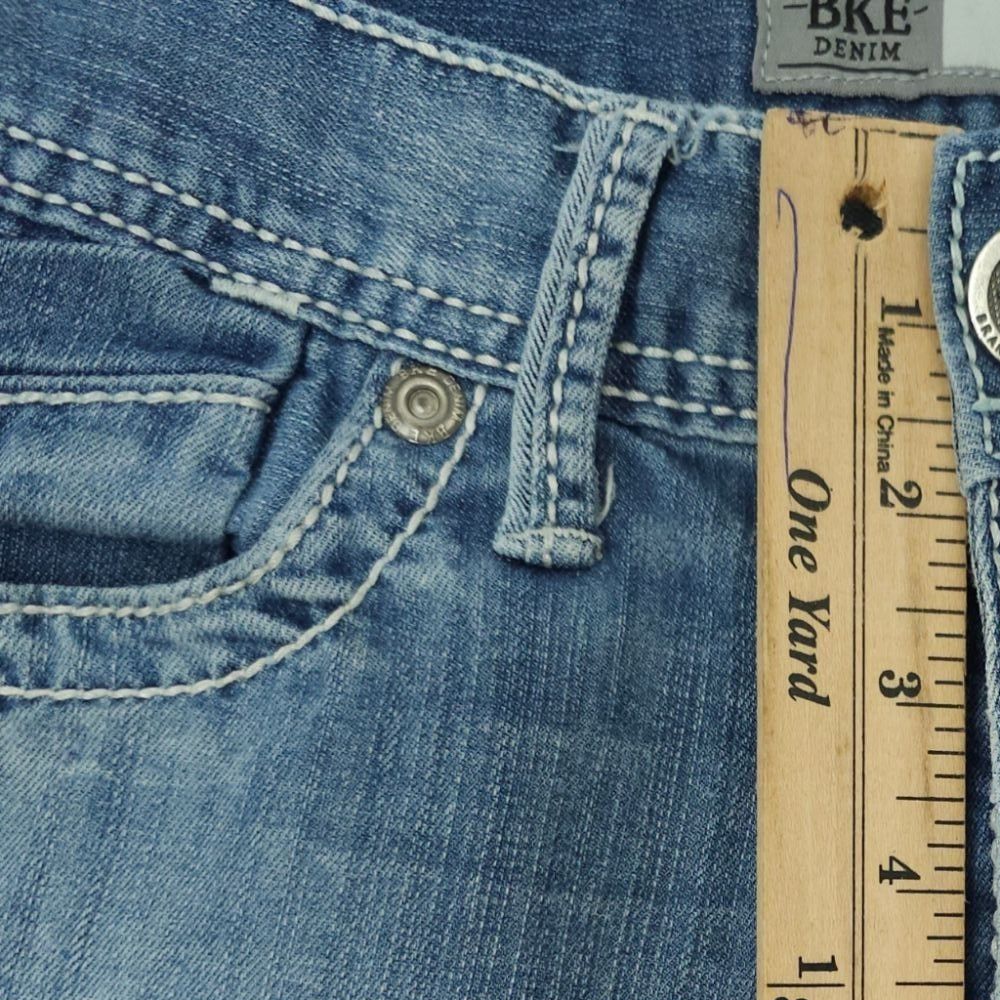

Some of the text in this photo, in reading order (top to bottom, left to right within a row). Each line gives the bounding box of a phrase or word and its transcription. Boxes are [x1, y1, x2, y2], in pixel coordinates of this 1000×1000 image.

[807, 0, 911, 36] BKE
[814, 36, 901, 62] DENIM
[880, 296, 922, 322] 1
[877, 326, 895, 474] Made in China
[880, 477, 922, 510] 2
[787, 468, 832, 707] One Yard
[878, 669, 922, 698] 3
[878, 855, 921, 885] 4
